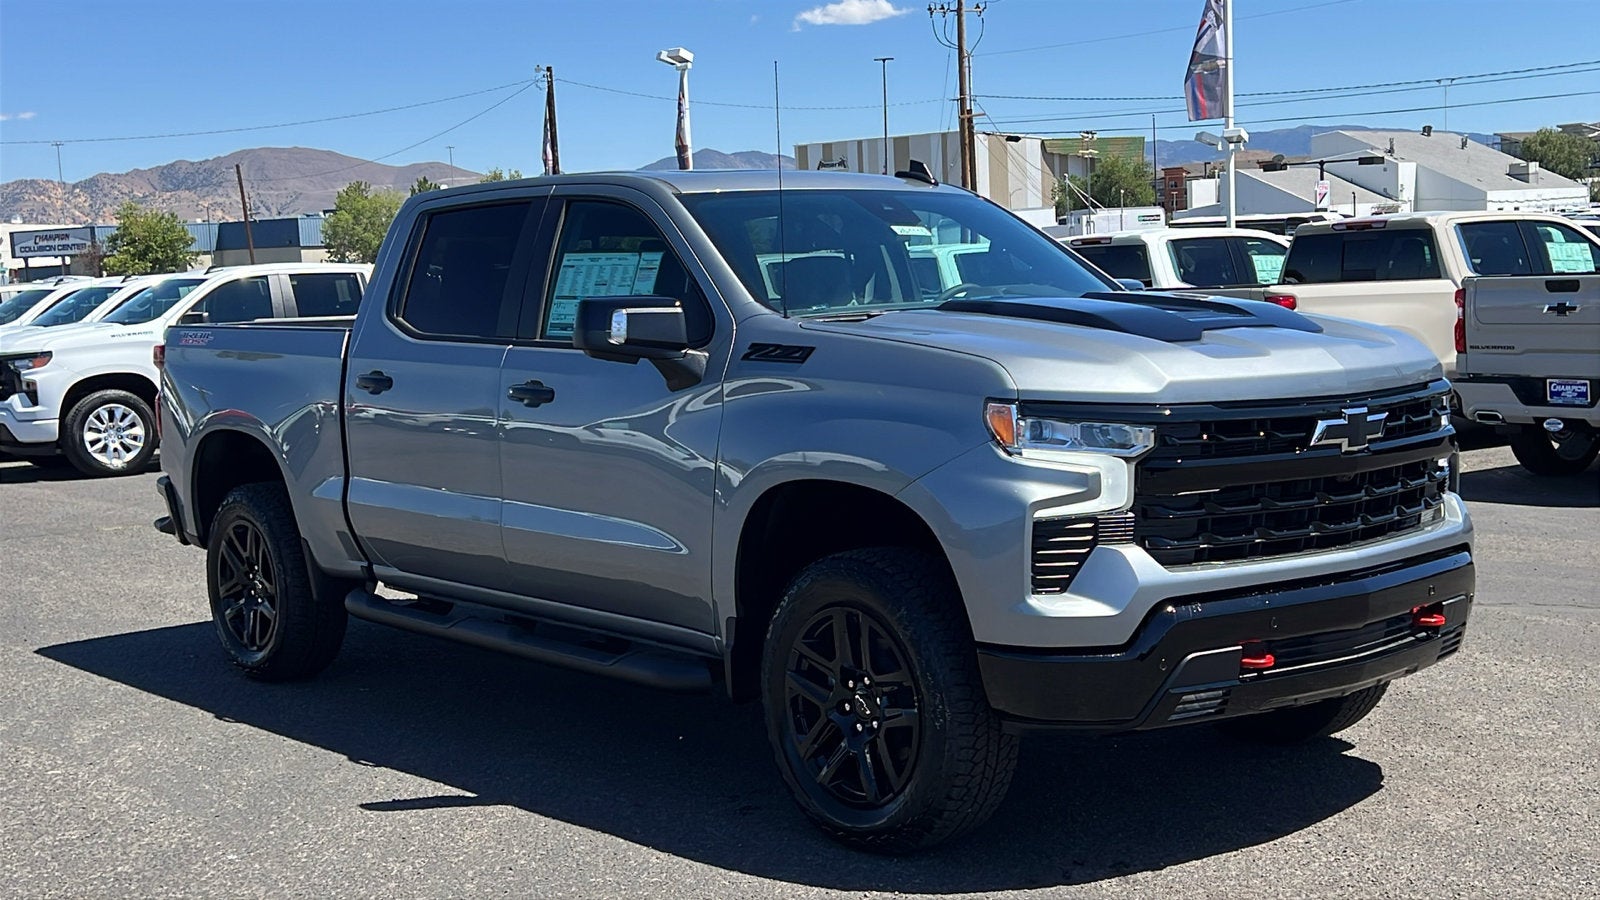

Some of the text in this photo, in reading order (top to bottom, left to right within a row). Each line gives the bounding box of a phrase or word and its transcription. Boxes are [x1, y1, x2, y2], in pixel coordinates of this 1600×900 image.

[34, 233, 70, 245] CHAMPION
[20, 243, 86, 253] COLLISION CENTER
[1550, 383, 1587, 392] CHAMPION
